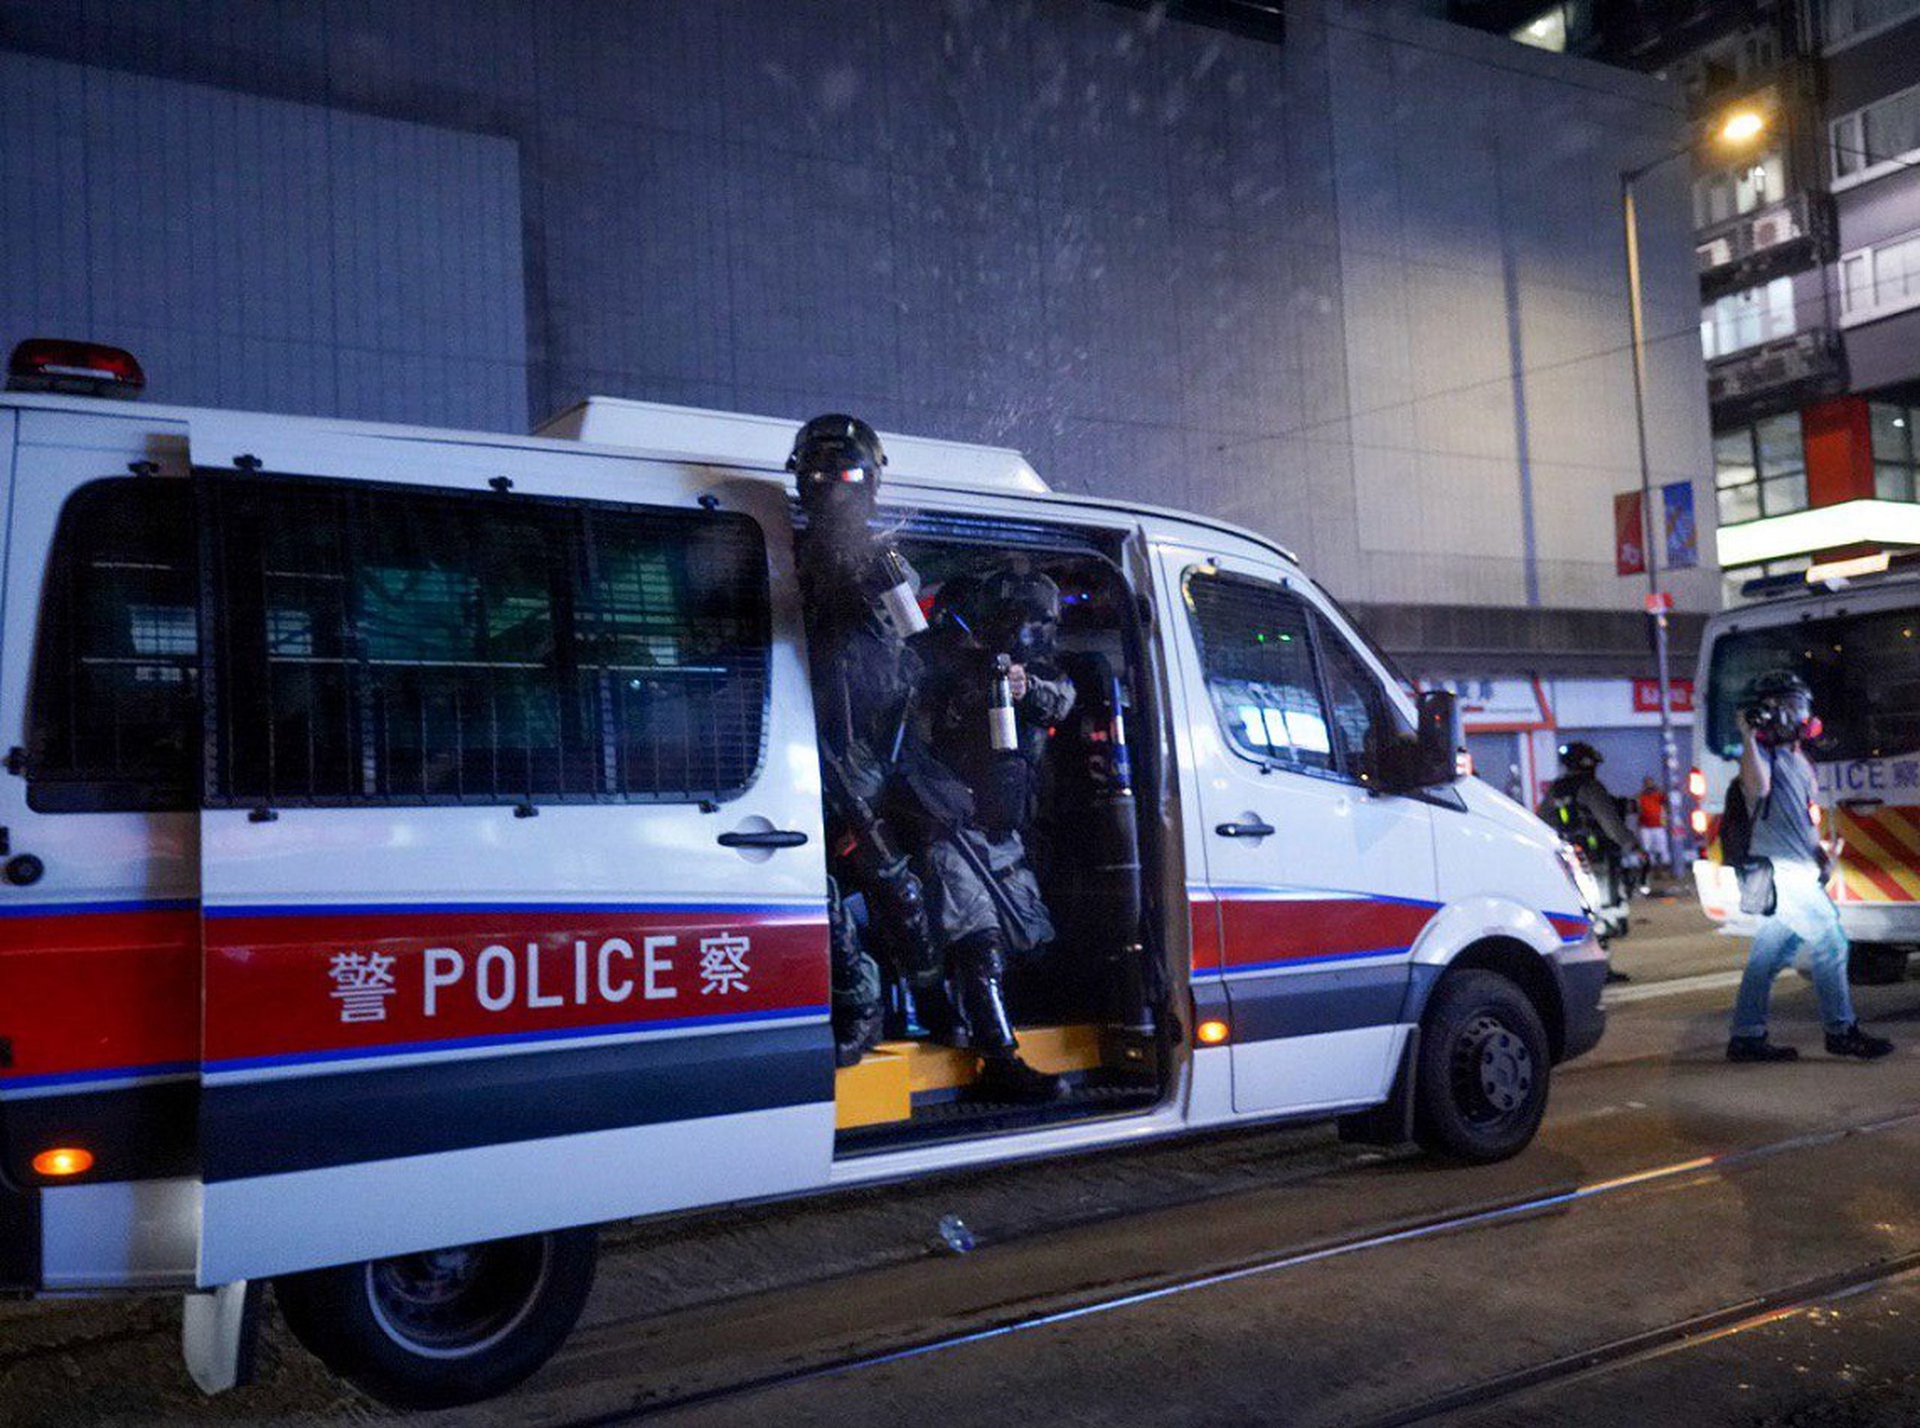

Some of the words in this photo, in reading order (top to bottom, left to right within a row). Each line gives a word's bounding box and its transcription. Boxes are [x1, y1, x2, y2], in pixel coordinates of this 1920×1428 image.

[1814, 760, 1884, 791] LICE
[328, 951, 397, 1023] 警
[423, 935, 678, 1017] POLICE
[699, 932, 751, 995] 察
